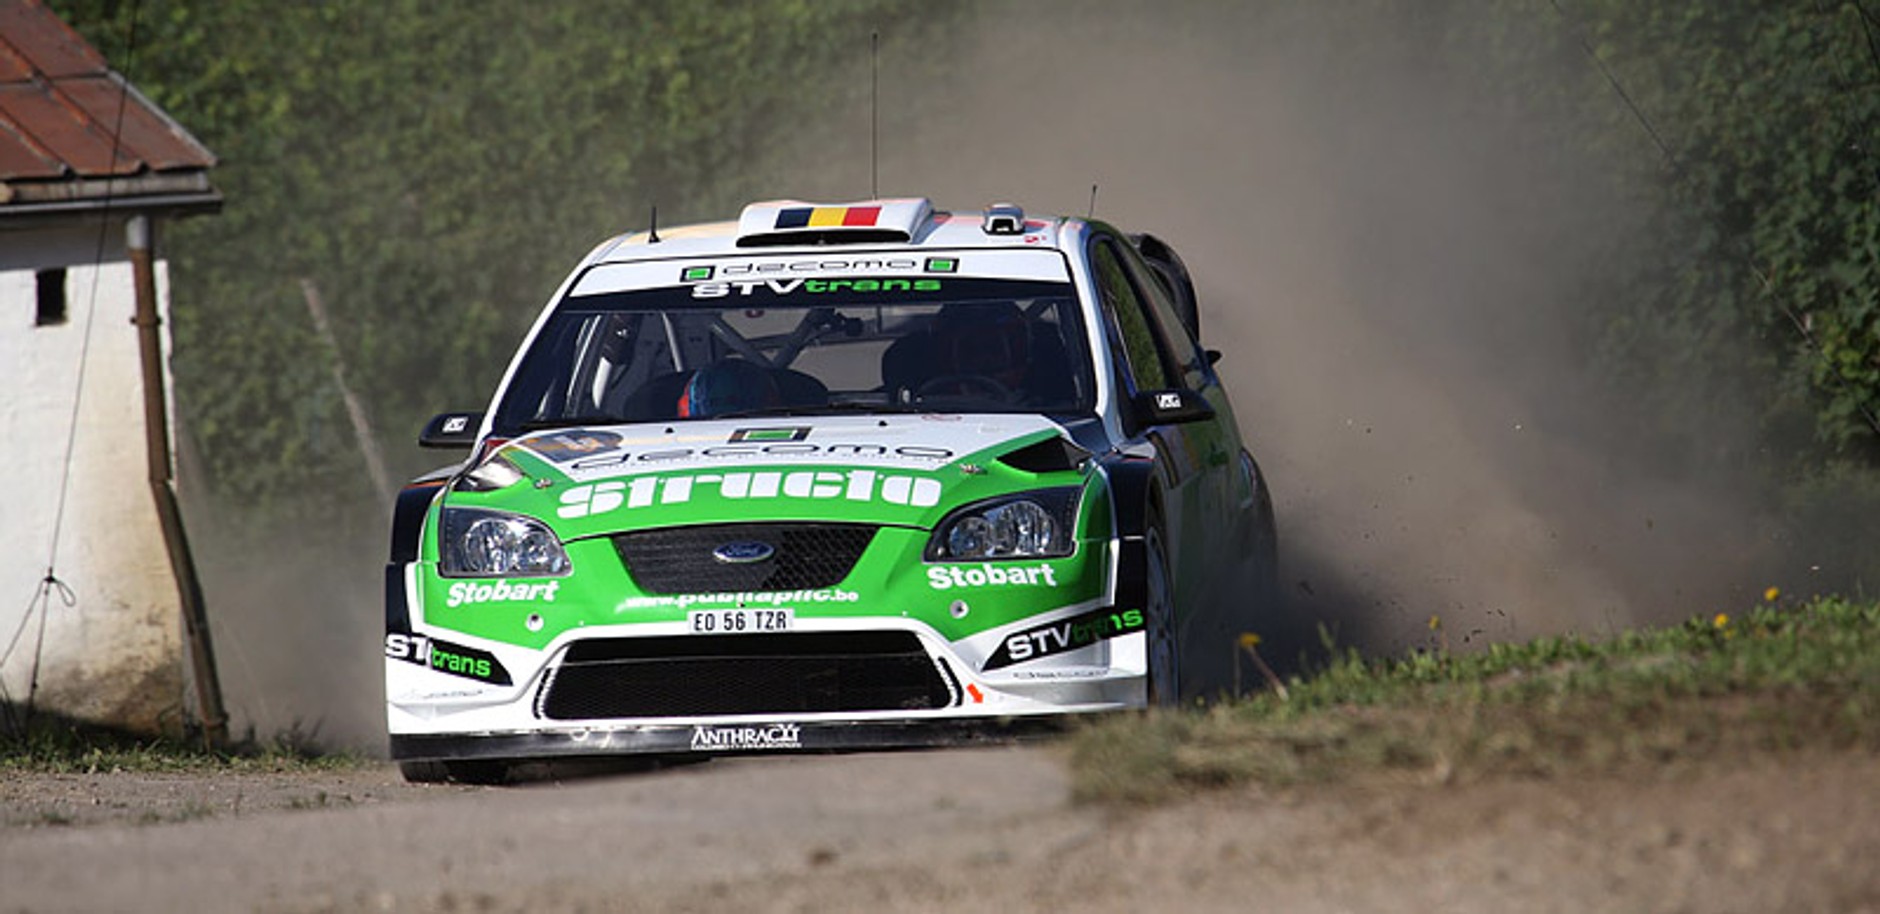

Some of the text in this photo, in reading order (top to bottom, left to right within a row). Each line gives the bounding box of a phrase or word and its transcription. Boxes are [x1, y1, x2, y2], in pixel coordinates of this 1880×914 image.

[691, 279, 942, 298] STVtrans
[927, 563, 1057, 589] Stobart
[446, 578, 560, 607] Stobart
[723, 611, 746, 631] 56
[754, 610, 787, 630] TZR
